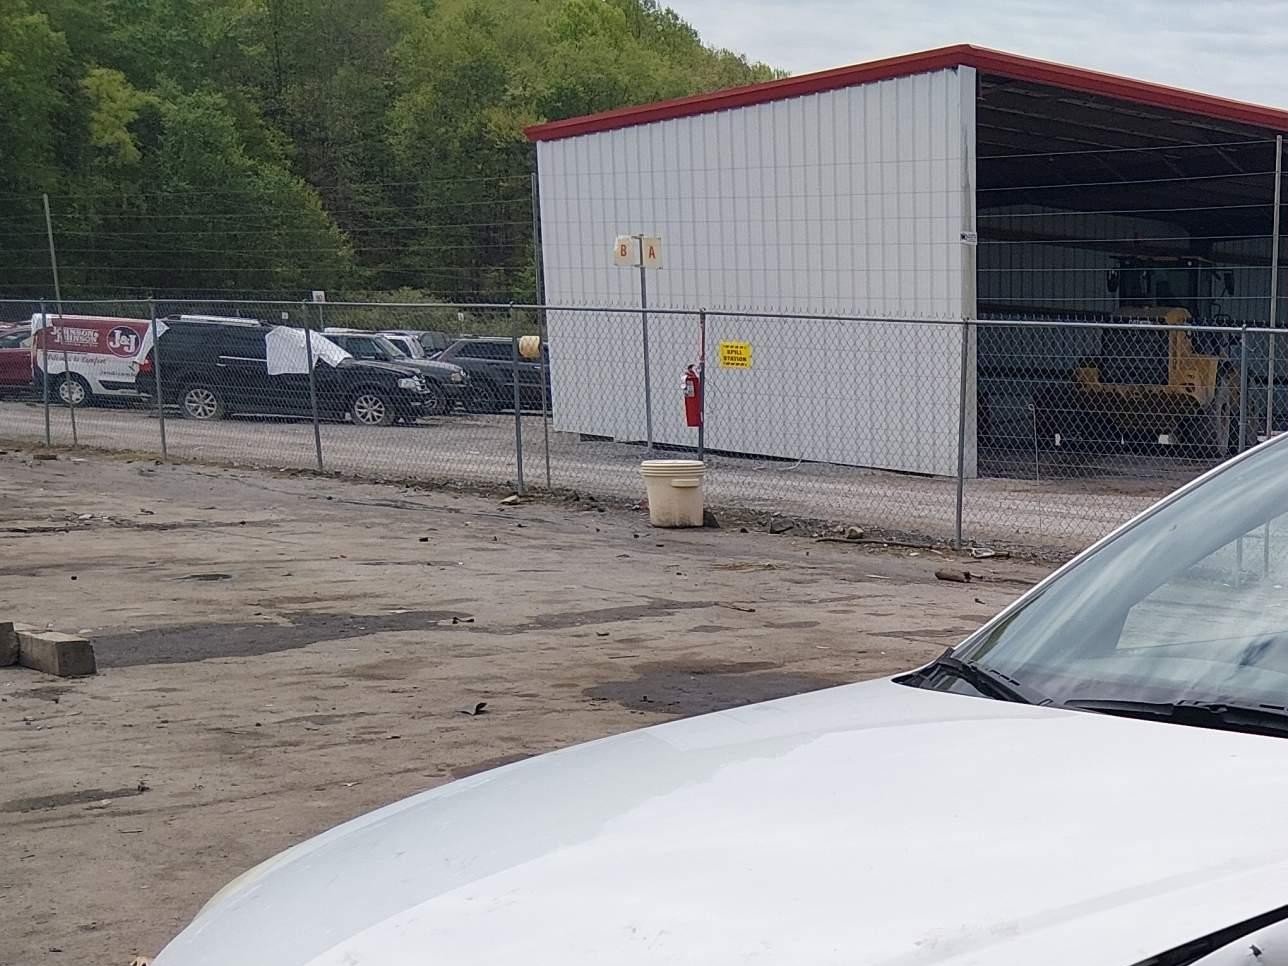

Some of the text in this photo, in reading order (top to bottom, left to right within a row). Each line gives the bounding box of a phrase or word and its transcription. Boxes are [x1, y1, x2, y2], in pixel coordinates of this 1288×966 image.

[620, 244, 627, 256] B
[648, 246, 656, 259] A
[109, 329, 137, 353] J&J
